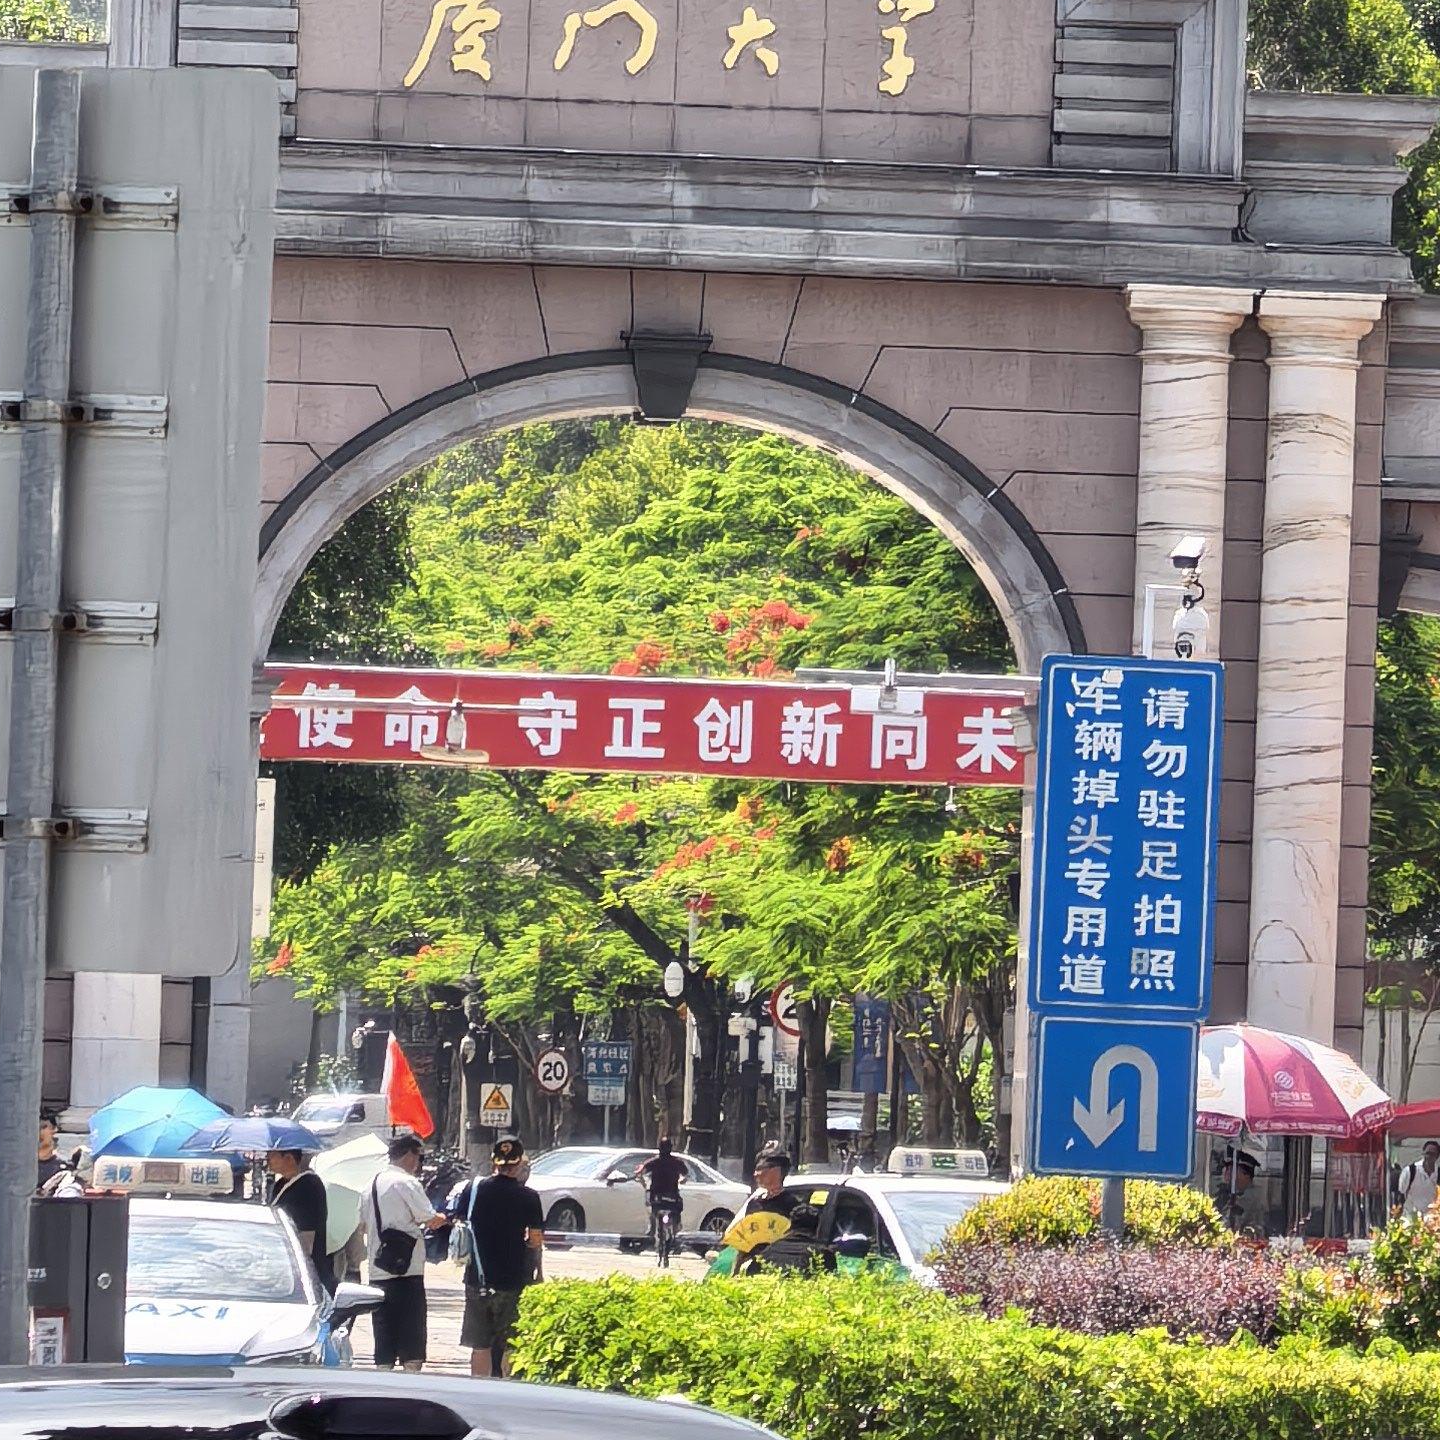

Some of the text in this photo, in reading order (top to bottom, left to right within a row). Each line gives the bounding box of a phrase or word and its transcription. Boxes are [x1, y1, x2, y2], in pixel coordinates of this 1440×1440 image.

[1059, 672, 1123, 996] 车辆掉头专用道
[1129, 686, 1189, 992] 请勿驻足拍照
[542, 1060, 565, 1081] 20
[128, 1303, 230, 1320] AXI
